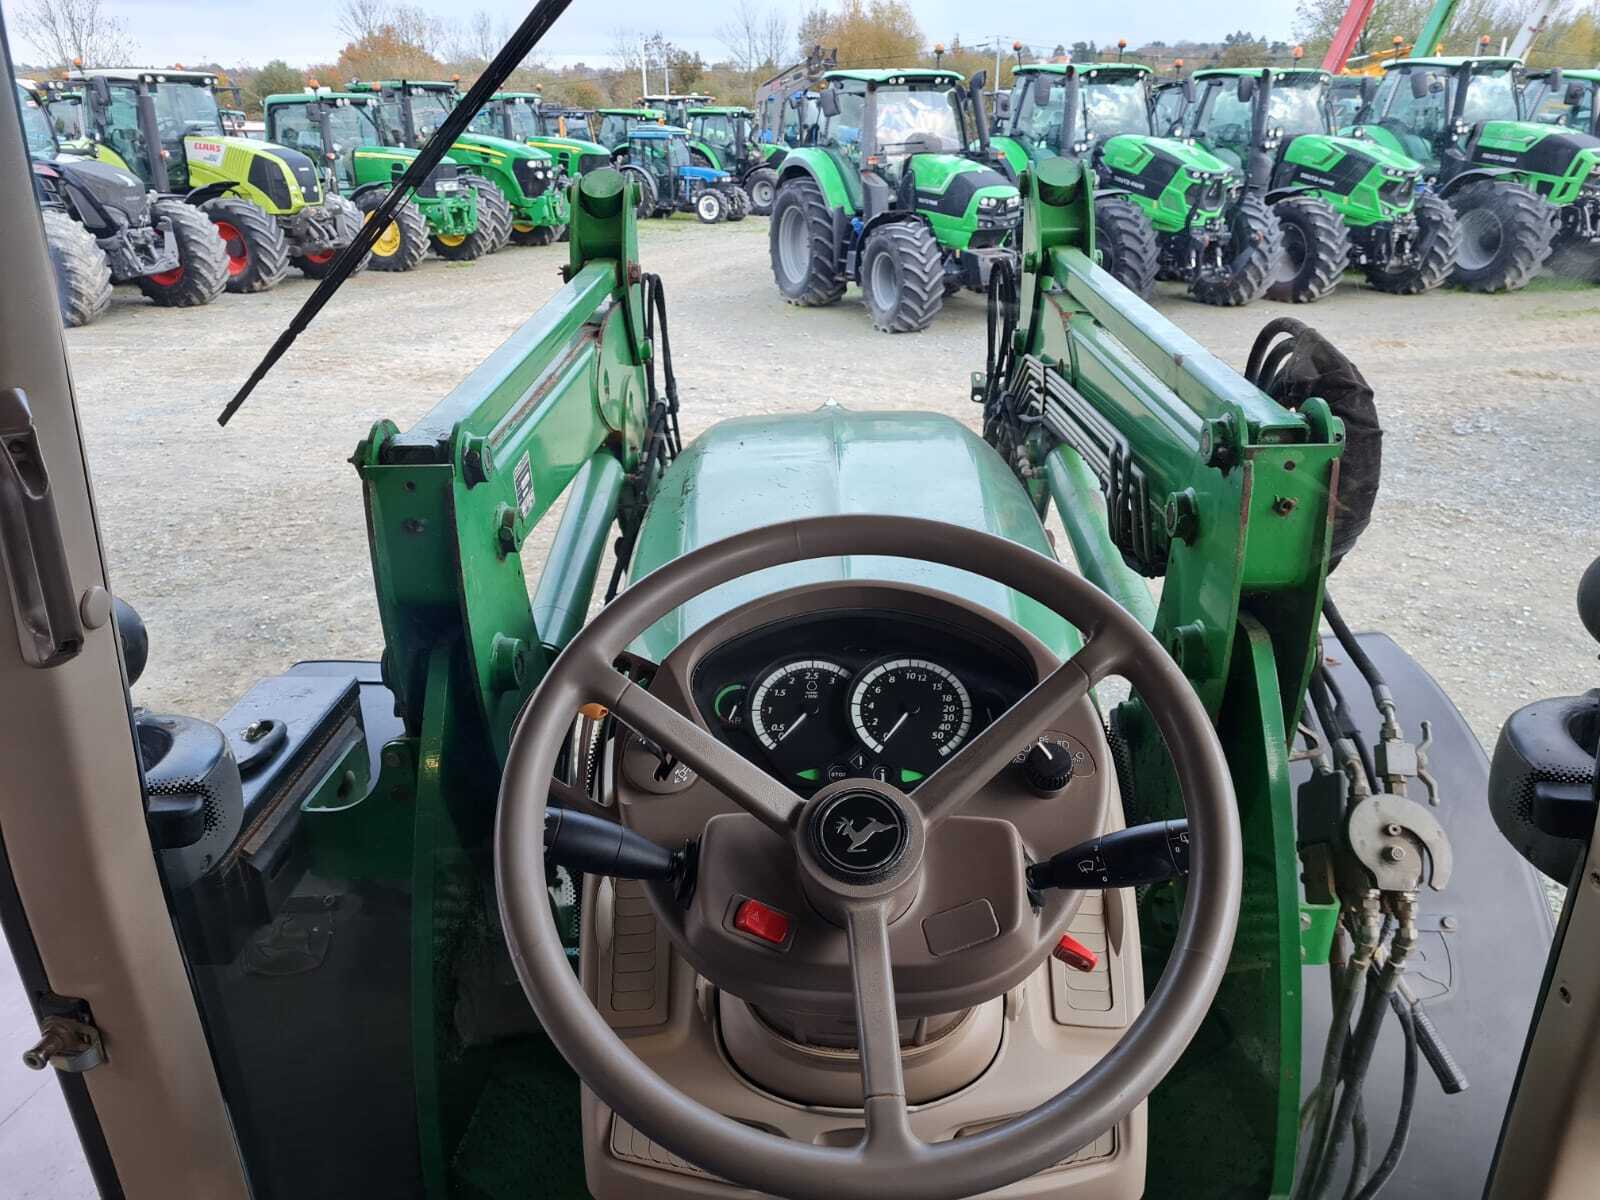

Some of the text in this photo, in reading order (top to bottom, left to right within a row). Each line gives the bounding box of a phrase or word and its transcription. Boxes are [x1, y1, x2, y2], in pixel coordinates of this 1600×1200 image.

[804, 672, 820, 680] 2.5
[905, 672, 917, 680] 10
[917, 674, 928, 682] 12
[788, 677, 796, 685] 2
[875, 686, 882, 694] 6
[932, 683, 944, 691] 15
[774, 689, 787, 697] 1.5
[942, 694, 953, 702] 18
[767, 706, 773, 714] 1
[943, 705, 955, 713] 20
[871, 718, 879, 726] 2
[943, 714, 955, 722] 30
[771, 723, 785, 732] 0.5
[939, 723, 951, 731] 40
[931, 731, 944, 740] 50
